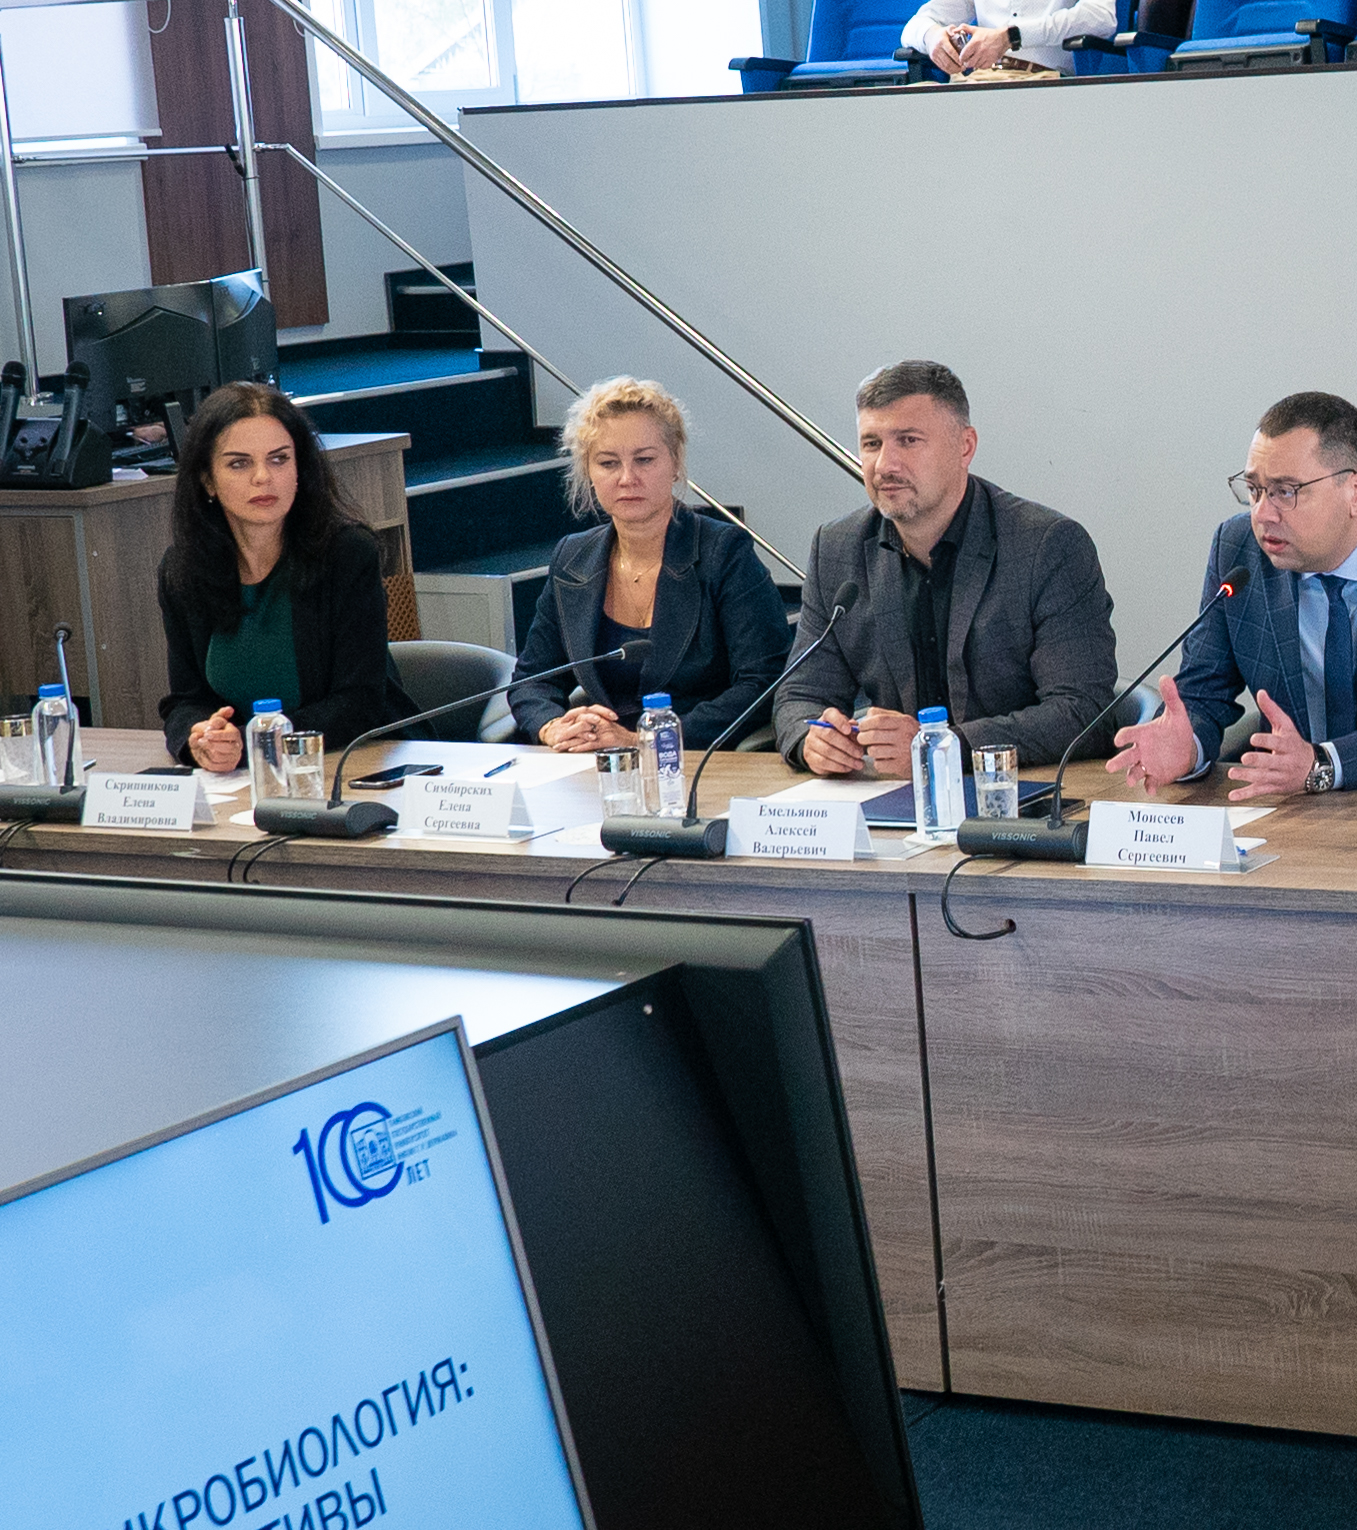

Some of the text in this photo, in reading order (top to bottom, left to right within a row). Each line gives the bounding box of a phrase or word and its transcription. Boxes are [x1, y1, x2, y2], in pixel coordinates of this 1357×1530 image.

[104, 778, 180, 793] Скрипникова
[424, 781, 493, 797] Симбирских
[122, 796, 156, 808] Елена
[438, 799, 472, 812] Елена
[758, 804, 828, 818] Емельянов
[1128, 810, 1185, 825] Моисеев
[97, 812, 178, 828] Владимировна
[424, 816, 481, 831] Сергеевна
[630, 829, 672, 839] VISSONIC
[764, 824, 817, 837] Алексей
[991, 832, 1037, 842] VISSONIC
[1133, 829, 1175, 844] Павел
[752, 841, 827, 859] Валерьевич
[1117, 847, 1187, 866] Сергеевич
[405, 1158, 432, 1187] ЛЕТ
[121, 1356, 475, 1530] КРОБИОЛОГИЯ:
[255, 1467, 387, 1530] ИВЫ
